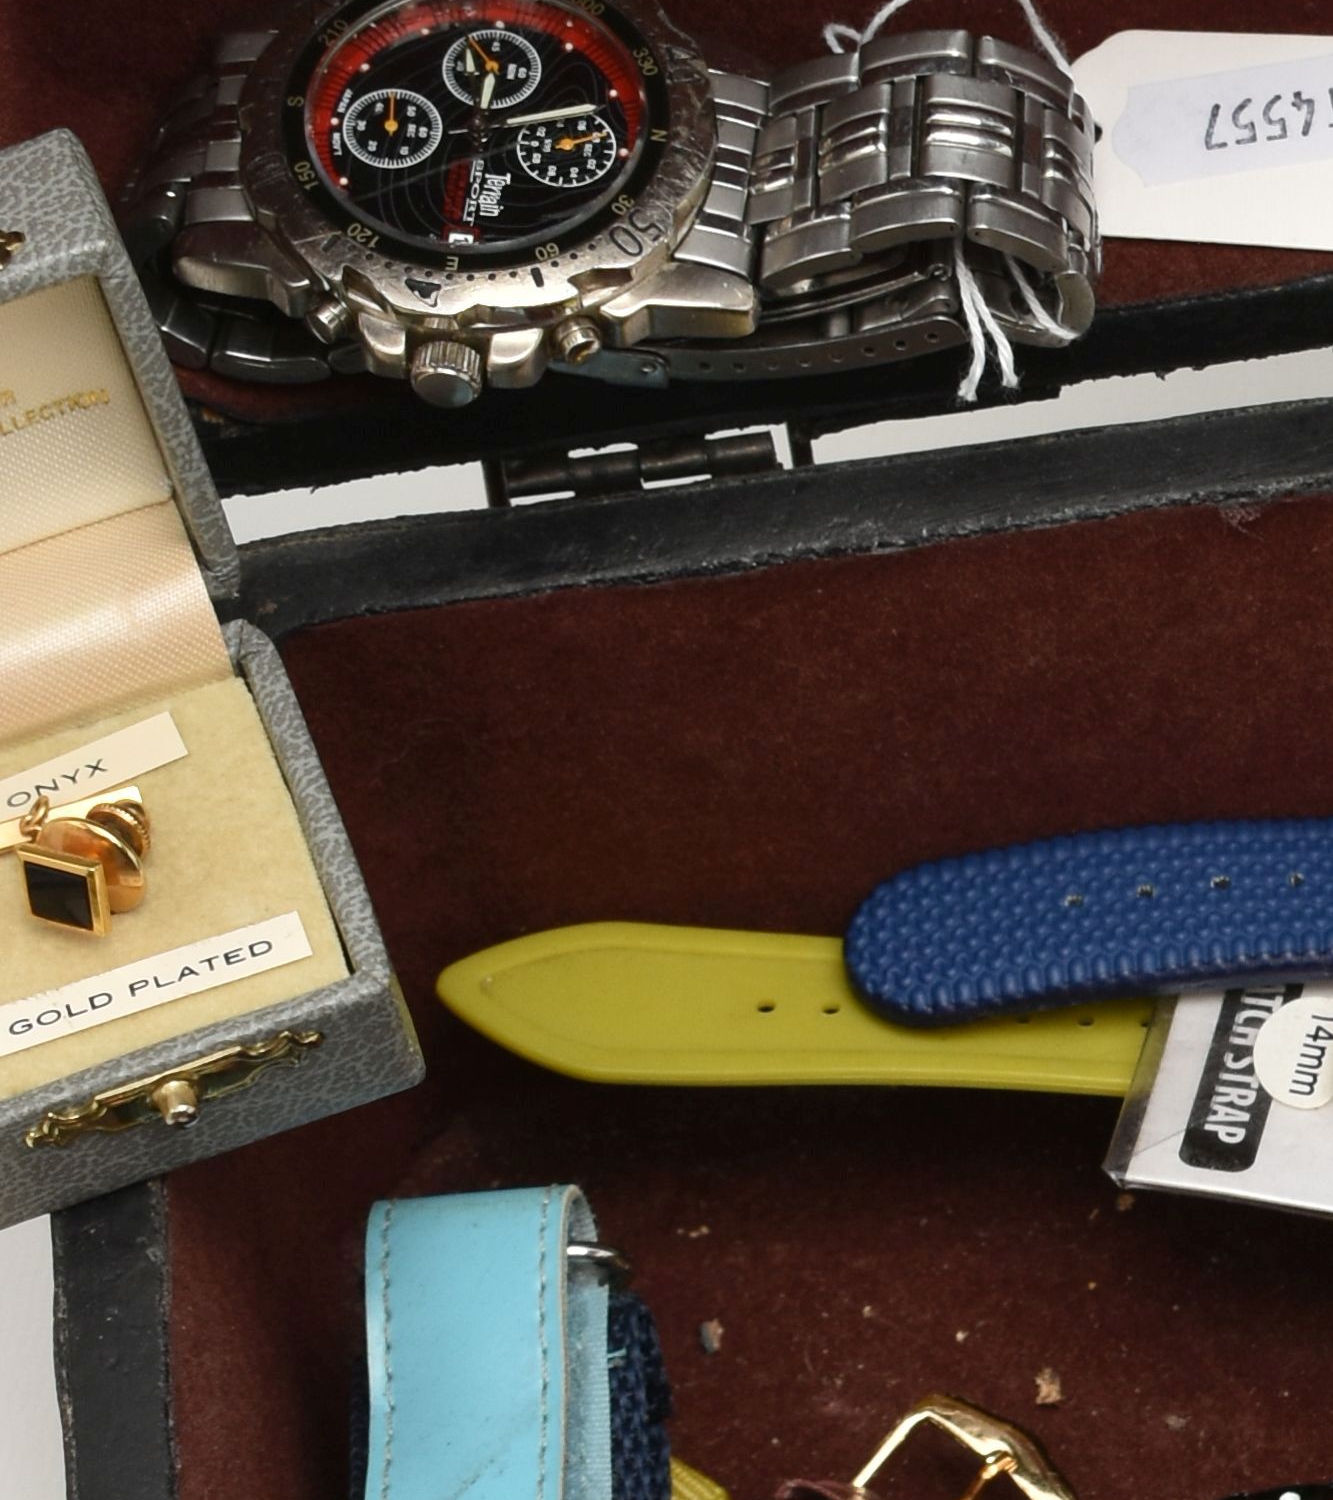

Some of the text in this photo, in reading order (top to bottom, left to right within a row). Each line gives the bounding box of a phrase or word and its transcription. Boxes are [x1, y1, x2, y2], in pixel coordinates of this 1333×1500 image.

[632, 47, 660, 76] 330
[294, 162, 321, 191] 150
[463, 159, 482, 226] SPORT
[480, 173, 512, 217] Terrain
[611, 193, 634, 215] 30
[346, 222, 380, 249] 120
[534, 243, 561, 261] 60
[609, 208, 667, 257] 50
[7, 759, 109, 808] ONYX
[9, 940, 274, 1036] GOLD PLATED
[1204, 1054, 1258, 1145] STRAP
